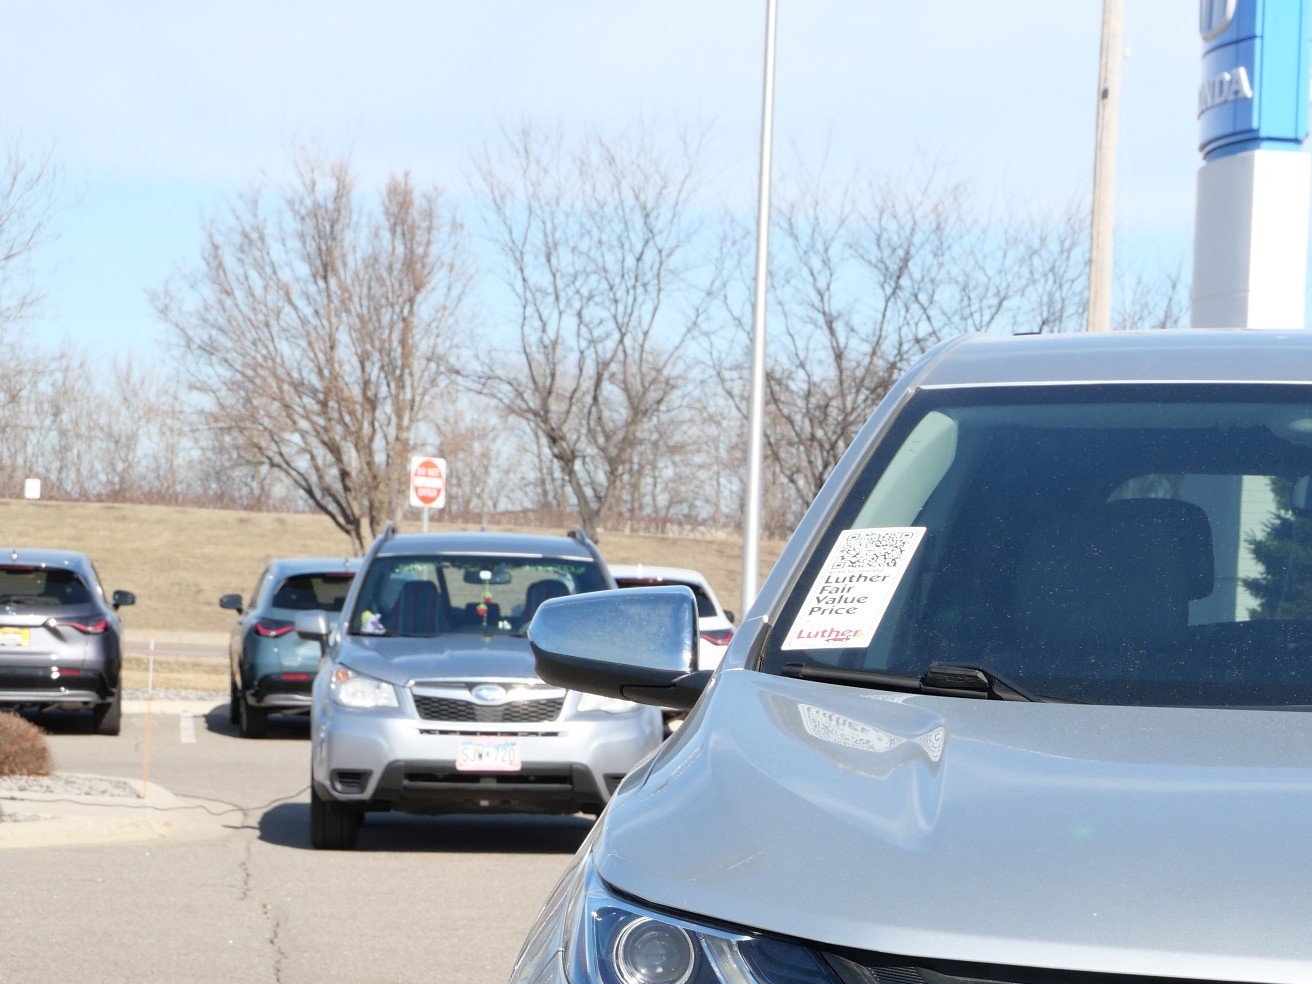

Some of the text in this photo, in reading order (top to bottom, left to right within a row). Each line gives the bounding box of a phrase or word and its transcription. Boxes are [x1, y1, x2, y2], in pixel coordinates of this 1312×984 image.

[824, 573, 890, 584] Luther
[819, 584, 855, 594] Fair
[815, 595, 871, 605] Value
[808, 605, 859, 616] Price
[796, 628, 862, 639] Luther
